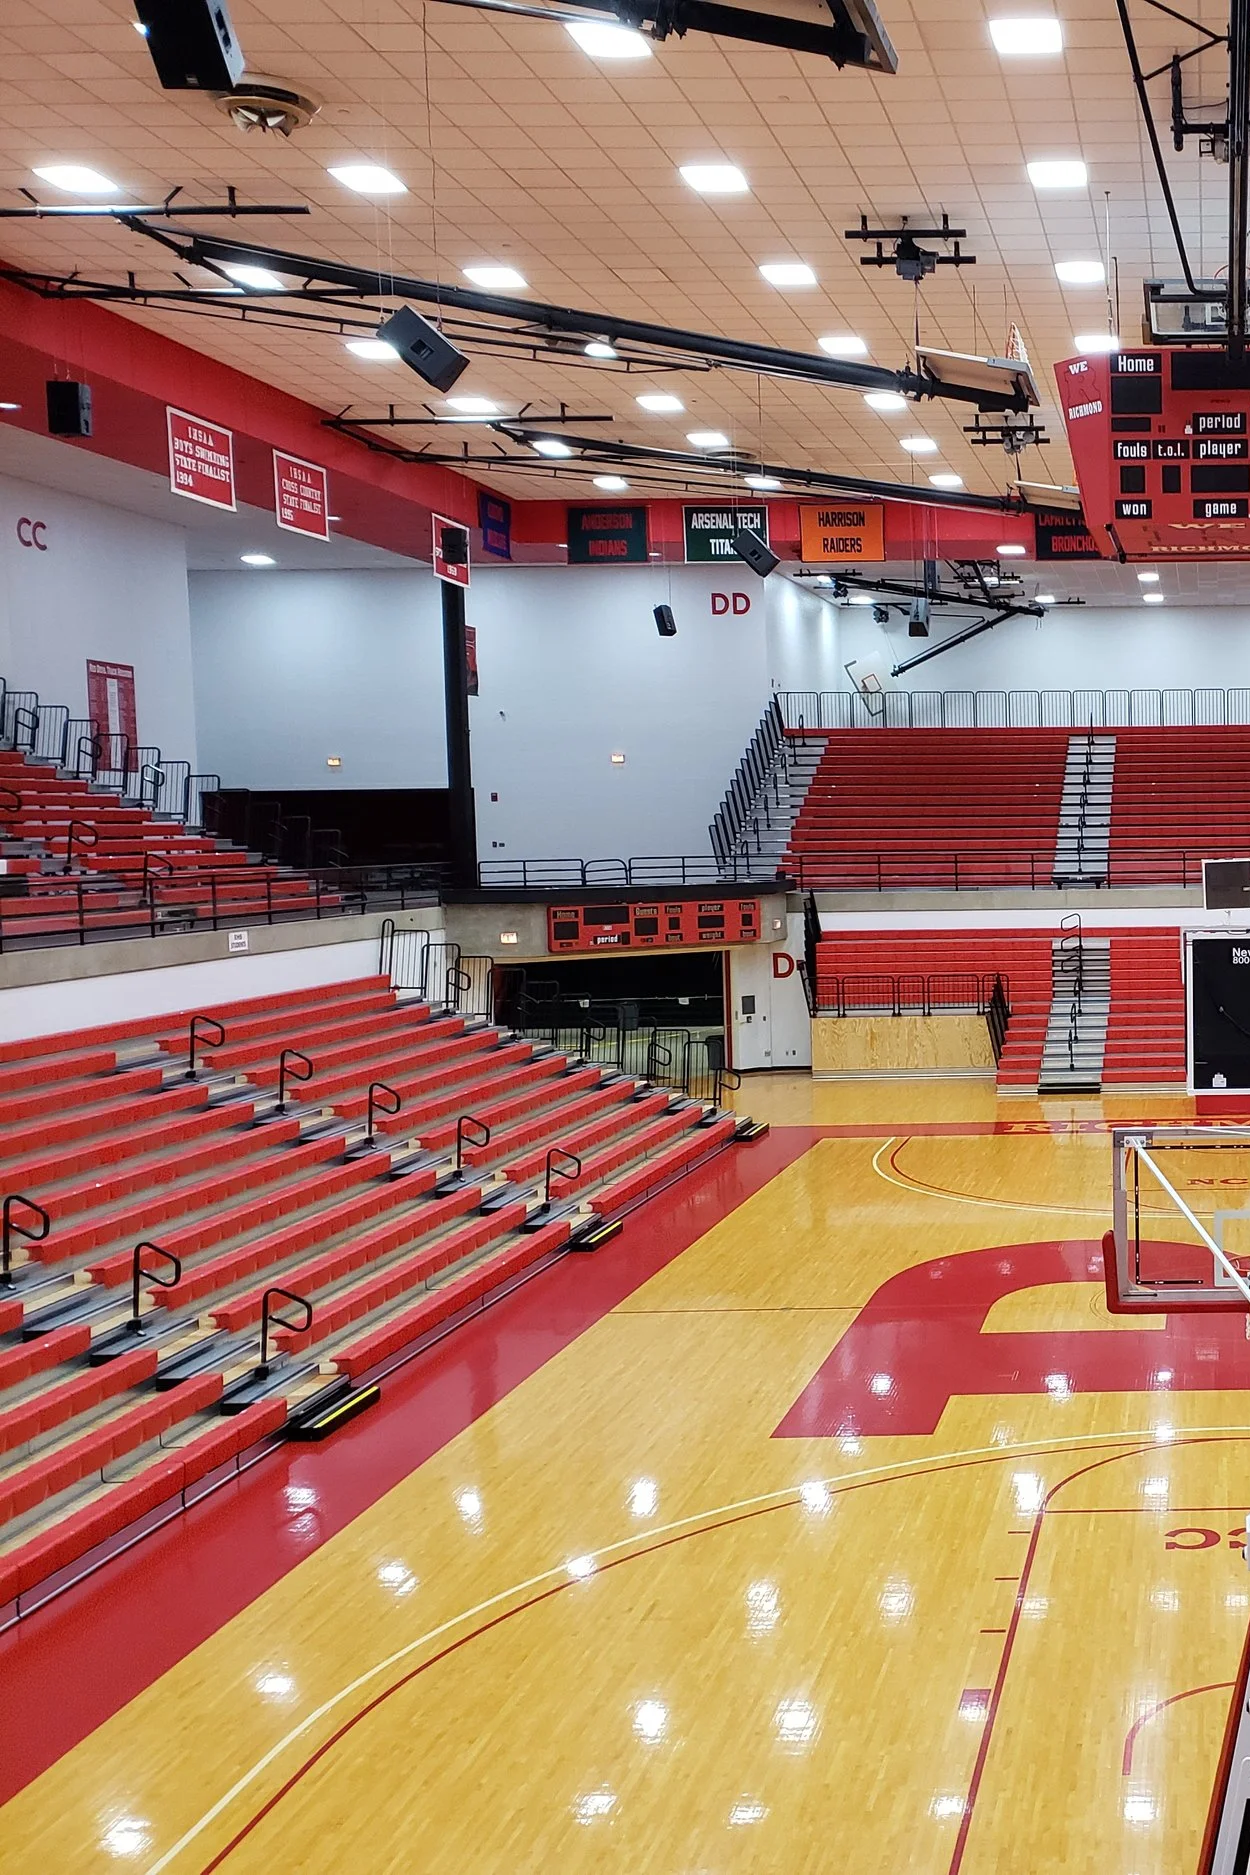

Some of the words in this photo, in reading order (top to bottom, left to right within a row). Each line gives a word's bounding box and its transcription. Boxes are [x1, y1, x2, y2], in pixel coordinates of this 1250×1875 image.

[1068, 361, 1088, 375] WE
[1118, 355, 1155, 372] Home
[1068, 400, 1104, 420] RICHMOND
[1199, 413, 1241, 432] period
[1117, 442, 1147, 457] fouls
[1158, 442, 1185, 457] t.o.l.
[1199, 440, 1241, 459] player
[1122, 503, 1147, 516] won
[1205, 502, 1237, 518] game
[691, 513, 734, 529] ARSENAL
[736, 513, 761, 529] TECH
[818, 511, 866, 528] HARRISON
[16, 516, 48, 551] CC
[822, 537, 862, 553] RAIDERS
[1051, 535, 1099, 553] BRONCHO
[711, 592, 751, 616] DD
[597, 934, 618, 945] period
[773, 953, 794, 978] D
